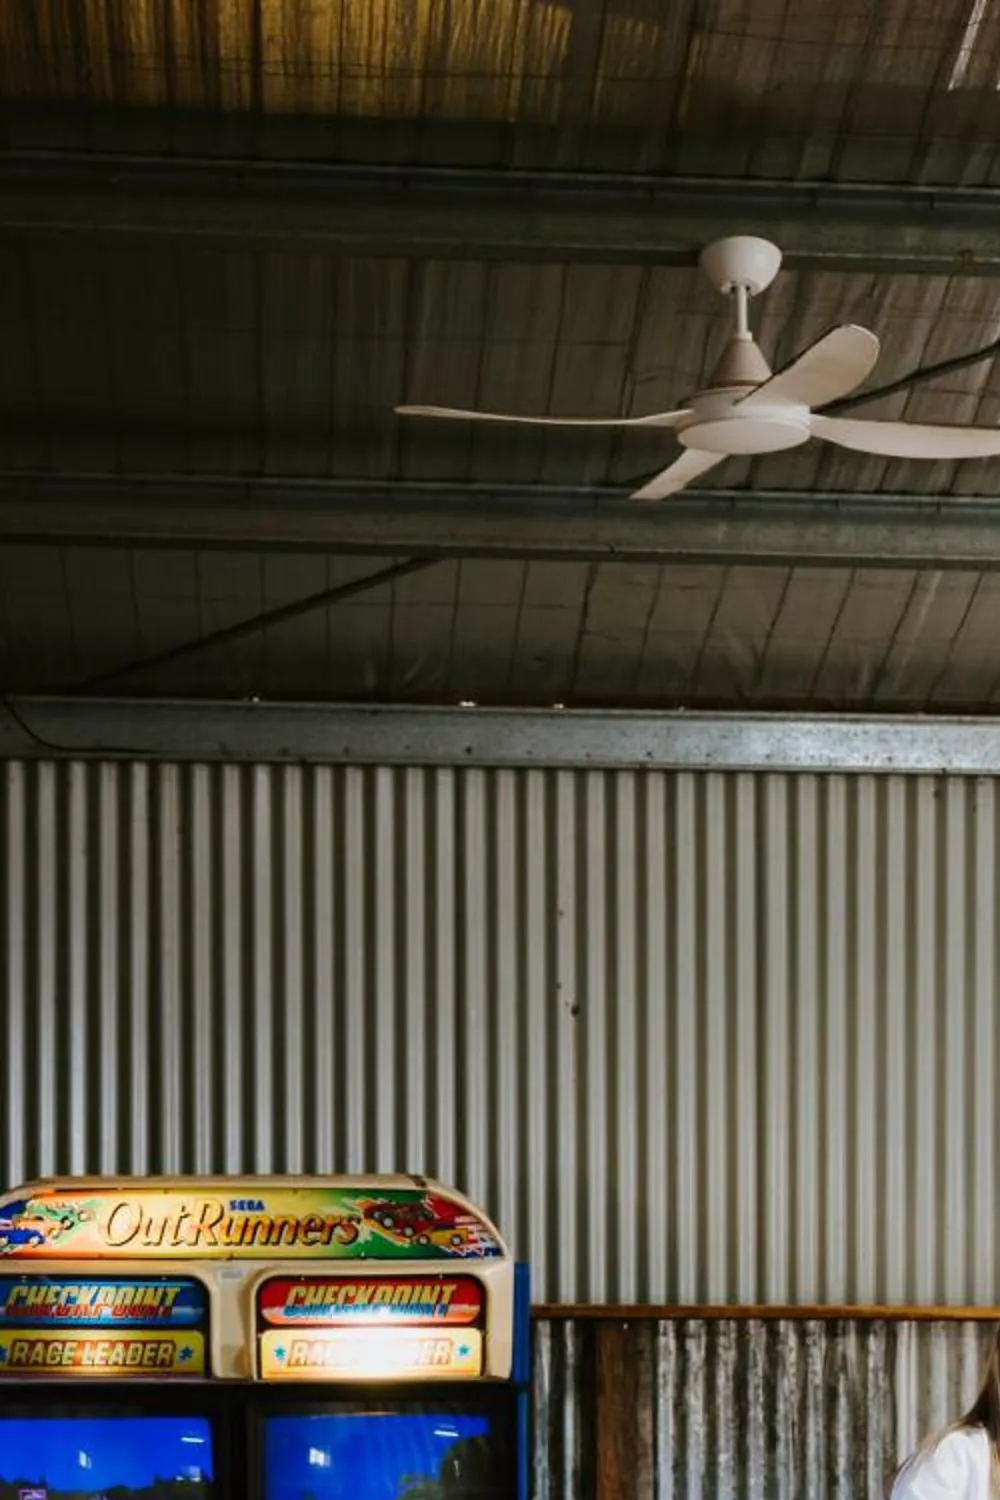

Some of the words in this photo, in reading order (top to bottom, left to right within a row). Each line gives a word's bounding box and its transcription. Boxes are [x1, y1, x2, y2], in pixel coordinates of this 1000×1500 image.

[229, 1200, 264, 1211] SEGA
[104, 1200, 360, 1248] OutRunners
[6, 1285, 180, 1317] CHECKPOINT
[284, 1284, 456, 1317] CHECKPOINT
[81, 1341, 174, 1366] LEADER
